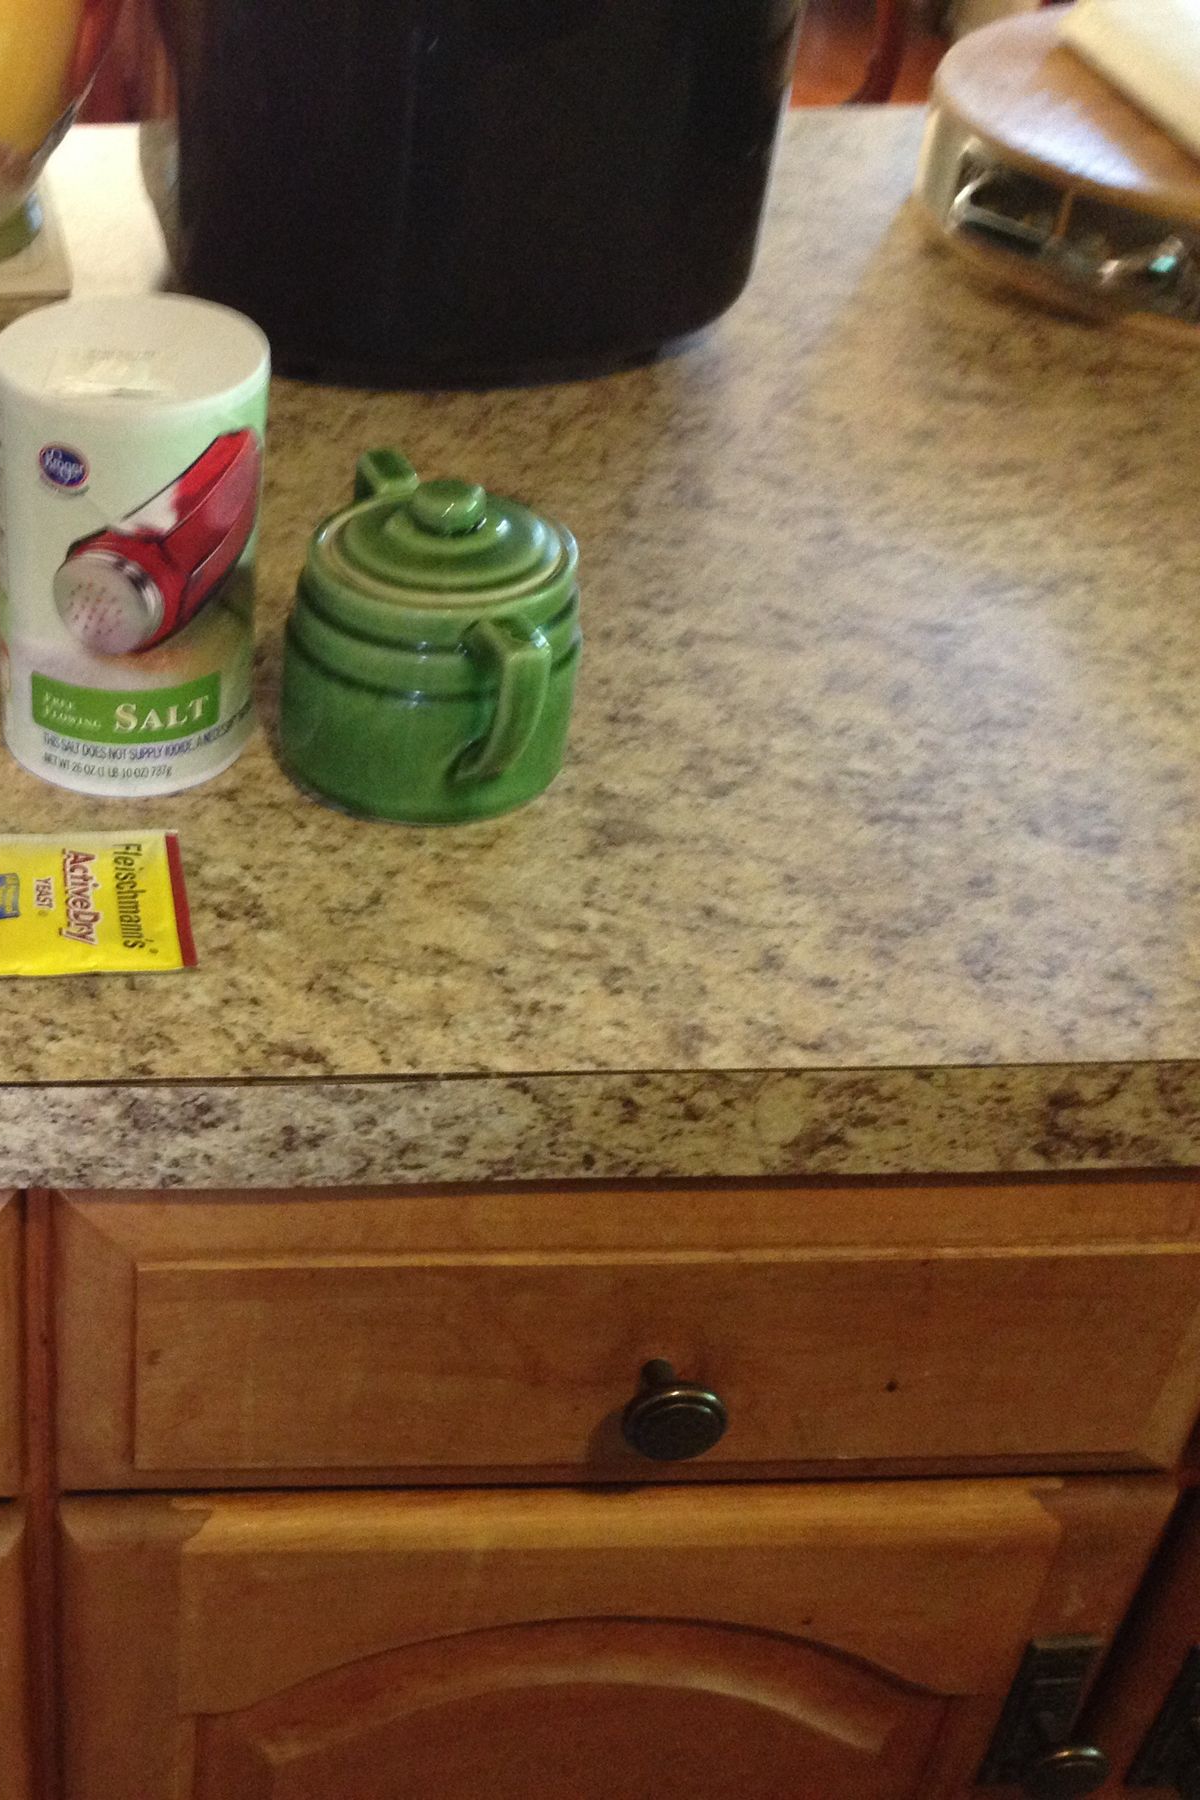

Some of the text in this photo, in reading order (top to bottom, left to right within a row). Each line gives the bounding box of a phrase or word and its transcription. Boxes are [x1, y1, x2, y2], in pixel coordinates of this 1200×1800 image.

[44, 449, 83, 483] Kroger
[113, 695, 209, 733] SALT
[33, 876, 55, 909] YEAST
[113, 843, 155, 950] Fleischmann's
